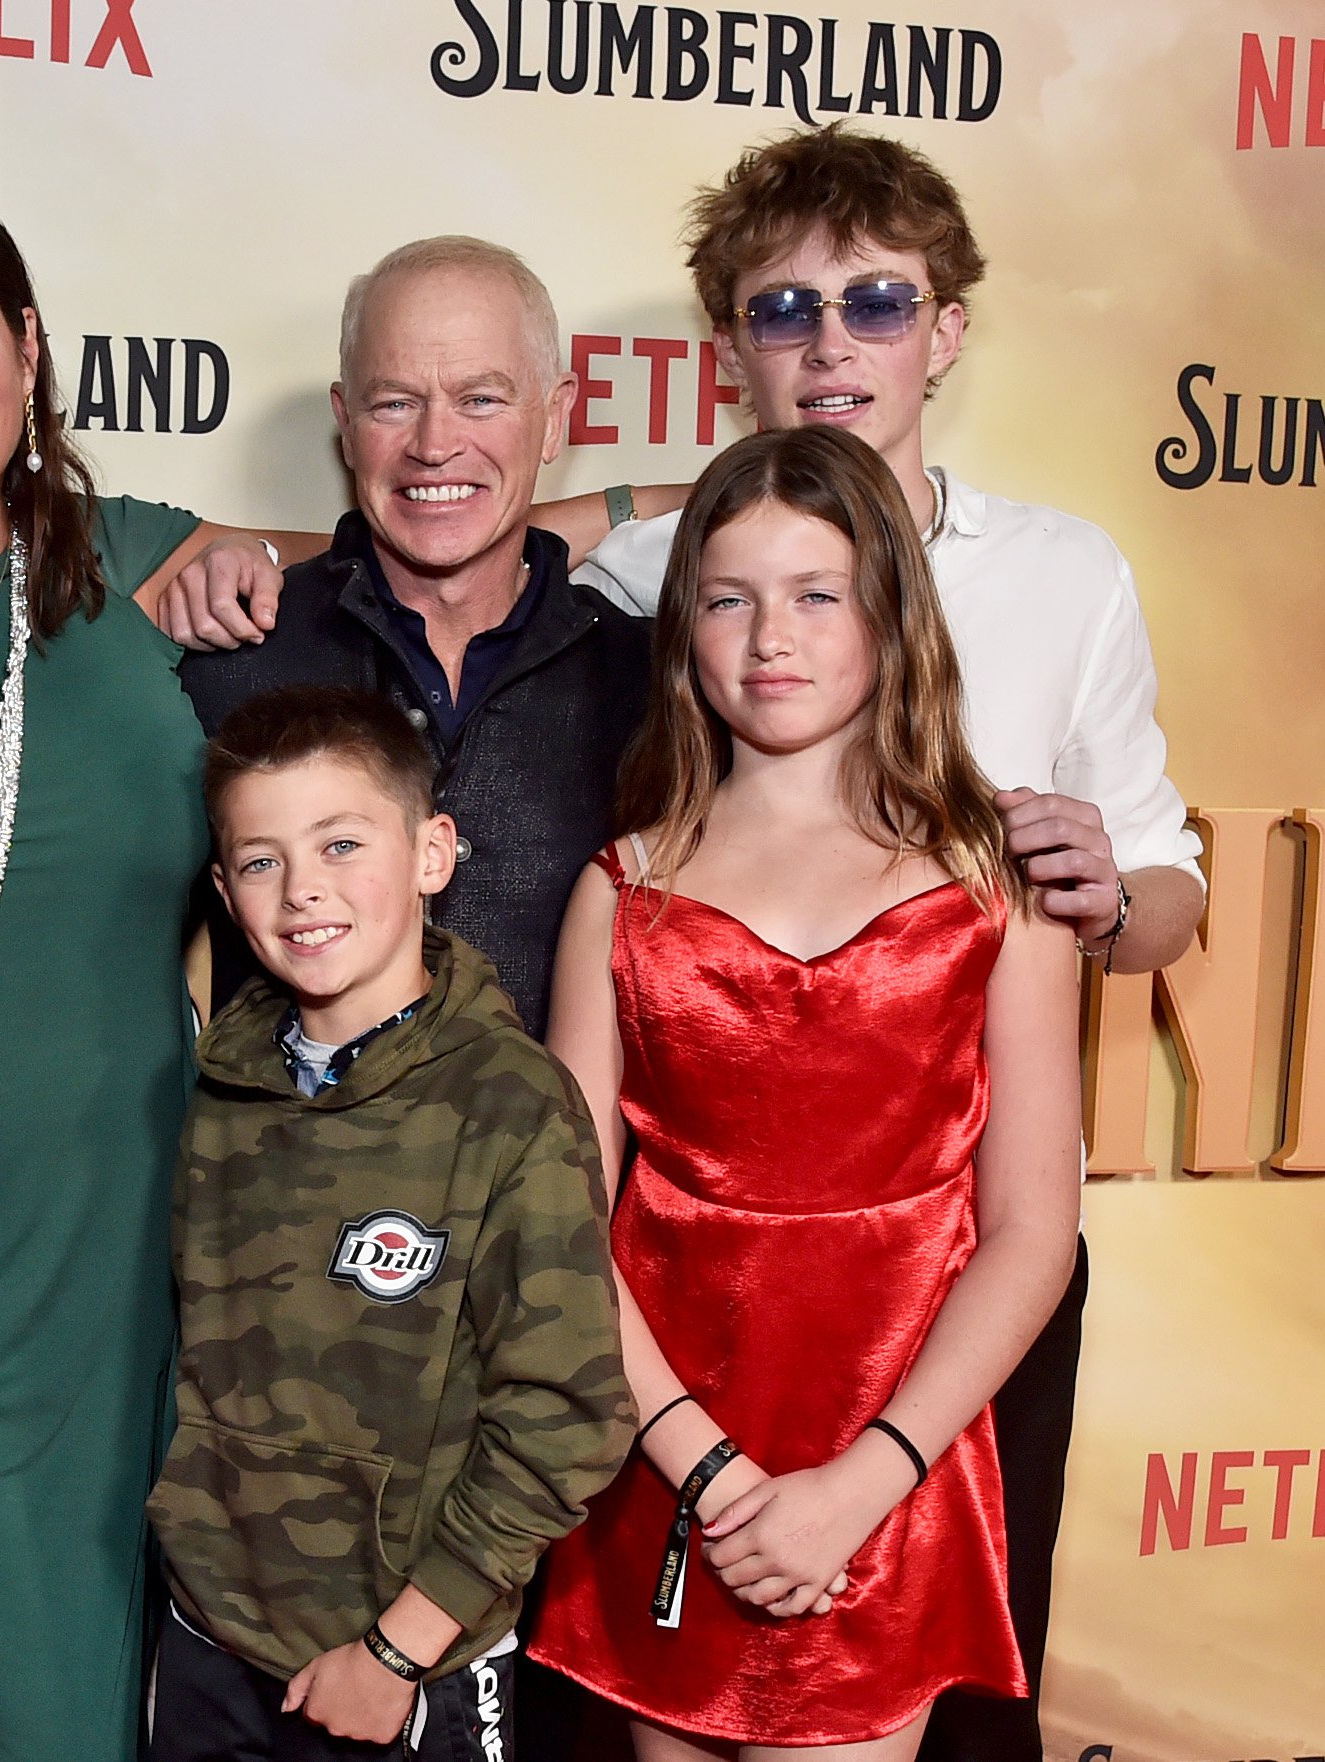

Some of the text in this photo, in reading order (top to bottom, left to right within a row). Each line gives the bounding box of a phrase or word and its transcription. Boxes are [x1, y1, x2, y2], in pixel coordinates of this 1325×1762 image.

[430, 0, 1003, 126] SLUMBERLAND
[344, 1239, 433, 1271] Drill
[1139, 1449, 1325, 1556] NET
[654, 1550, 680, 1609] SLUMBERLAND
